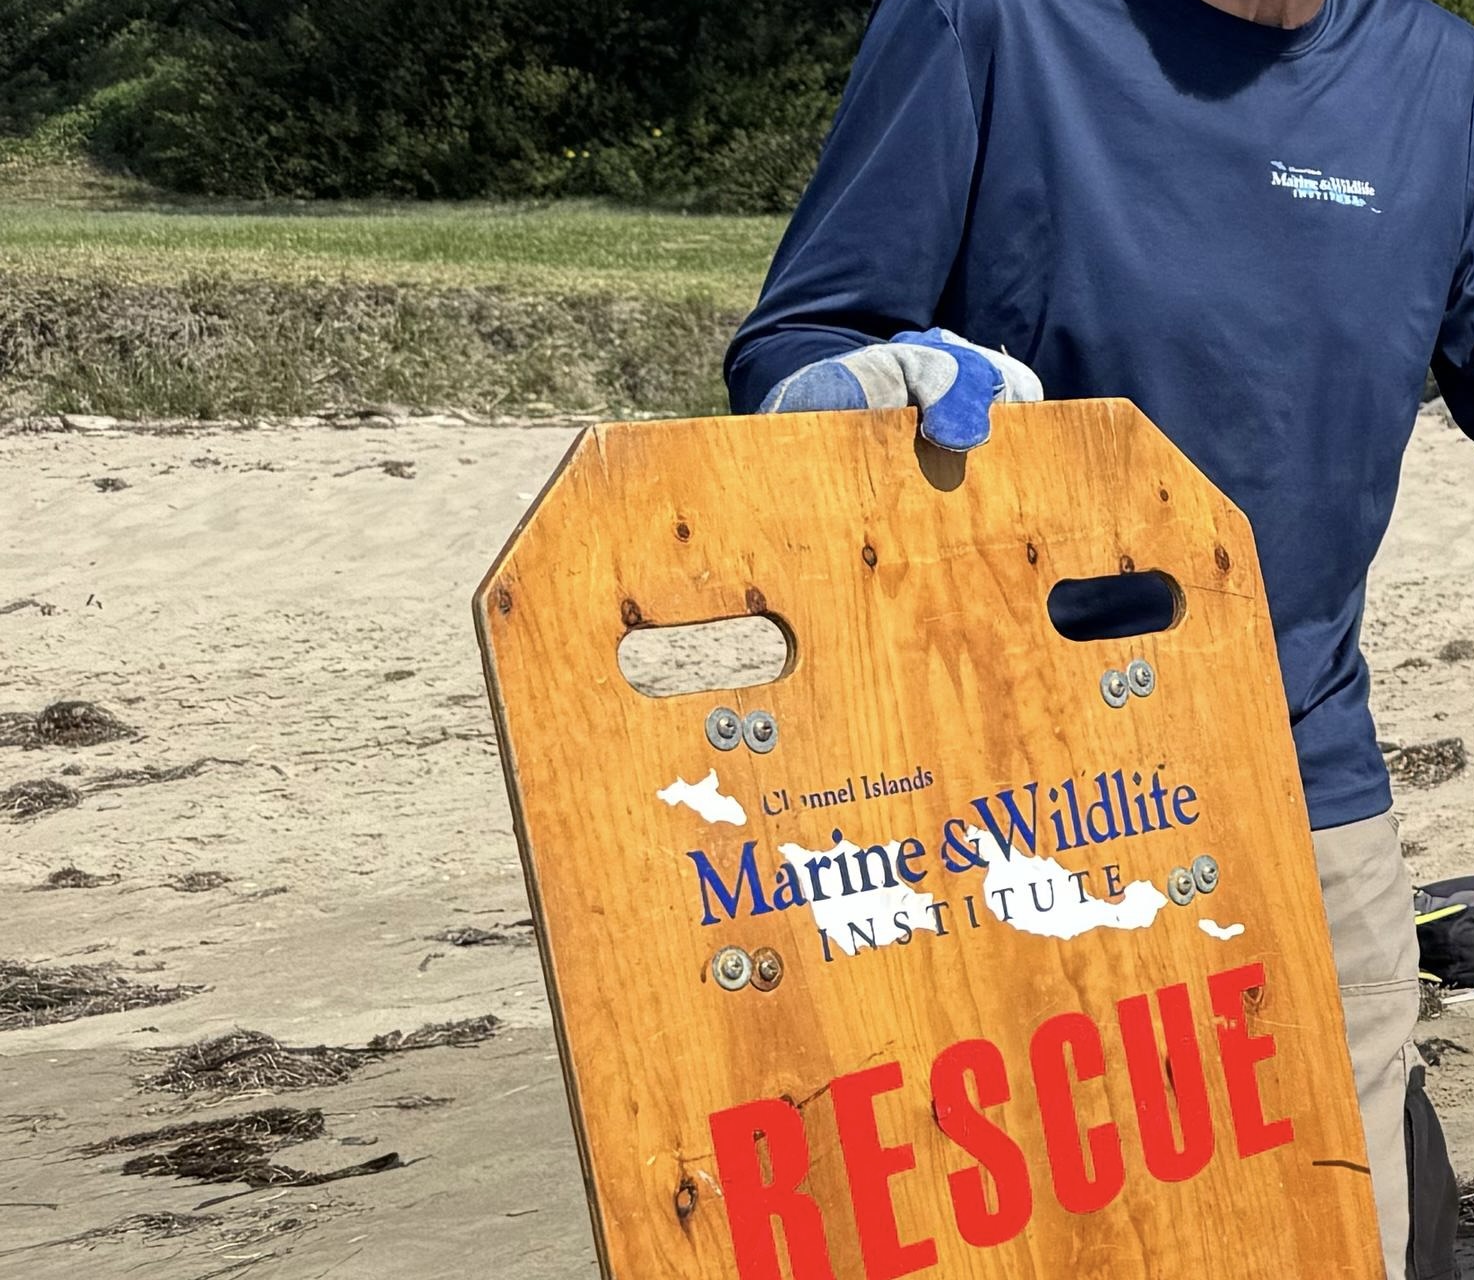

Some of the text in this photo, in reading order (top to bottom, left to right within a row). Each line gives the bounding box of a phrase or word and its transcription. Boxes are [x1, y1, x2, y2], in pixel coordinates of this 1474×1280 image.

[860, 765, 935, 800] Islands
[686, 827, 928, 927] Marine
[971, 767, 1201, 864] Wildlife
[817, 863, 1127, 963] INSTITUTE
